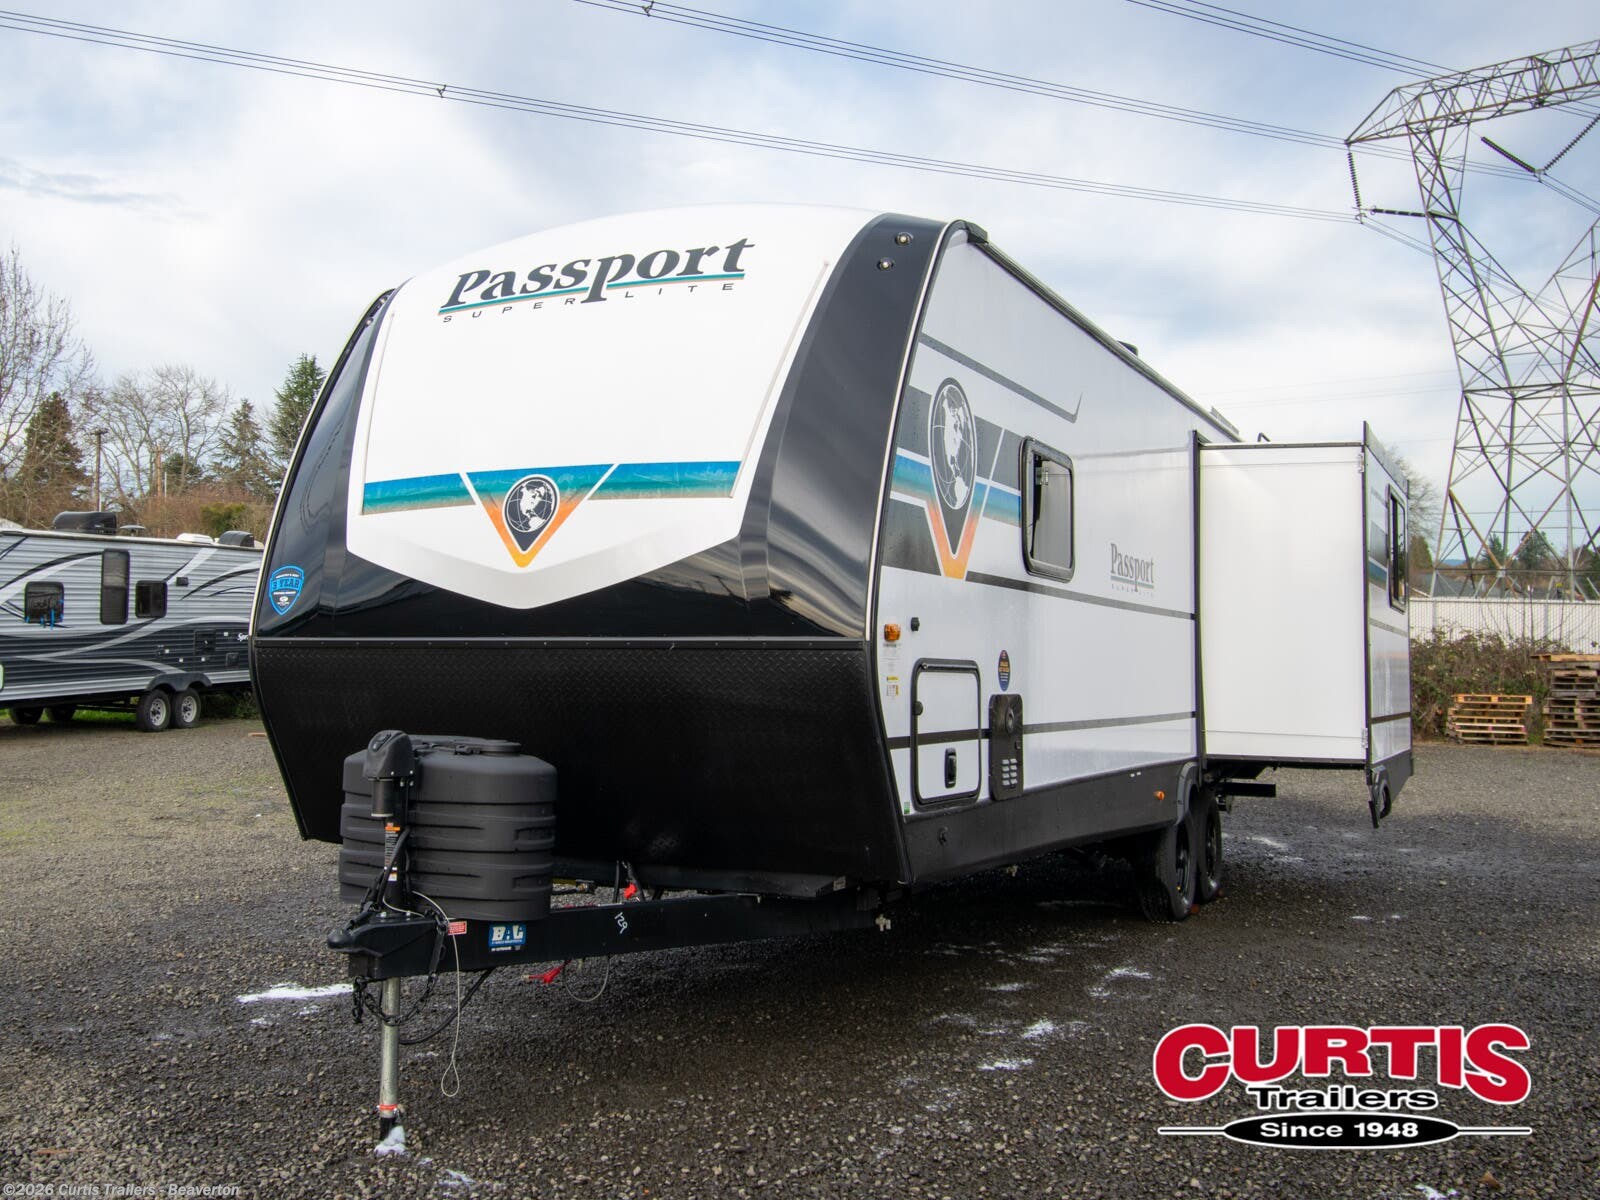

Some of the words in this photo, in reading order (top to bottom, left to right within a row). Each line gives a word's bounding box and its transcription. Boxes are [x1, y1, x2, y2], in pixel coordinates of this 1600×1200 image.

[440, 238, 756, 309] Passport
[443, 298, 576, 323] SUPER
[624, 283, 734, 299] LITE
[1110, 543, 1154, 592] Passport
